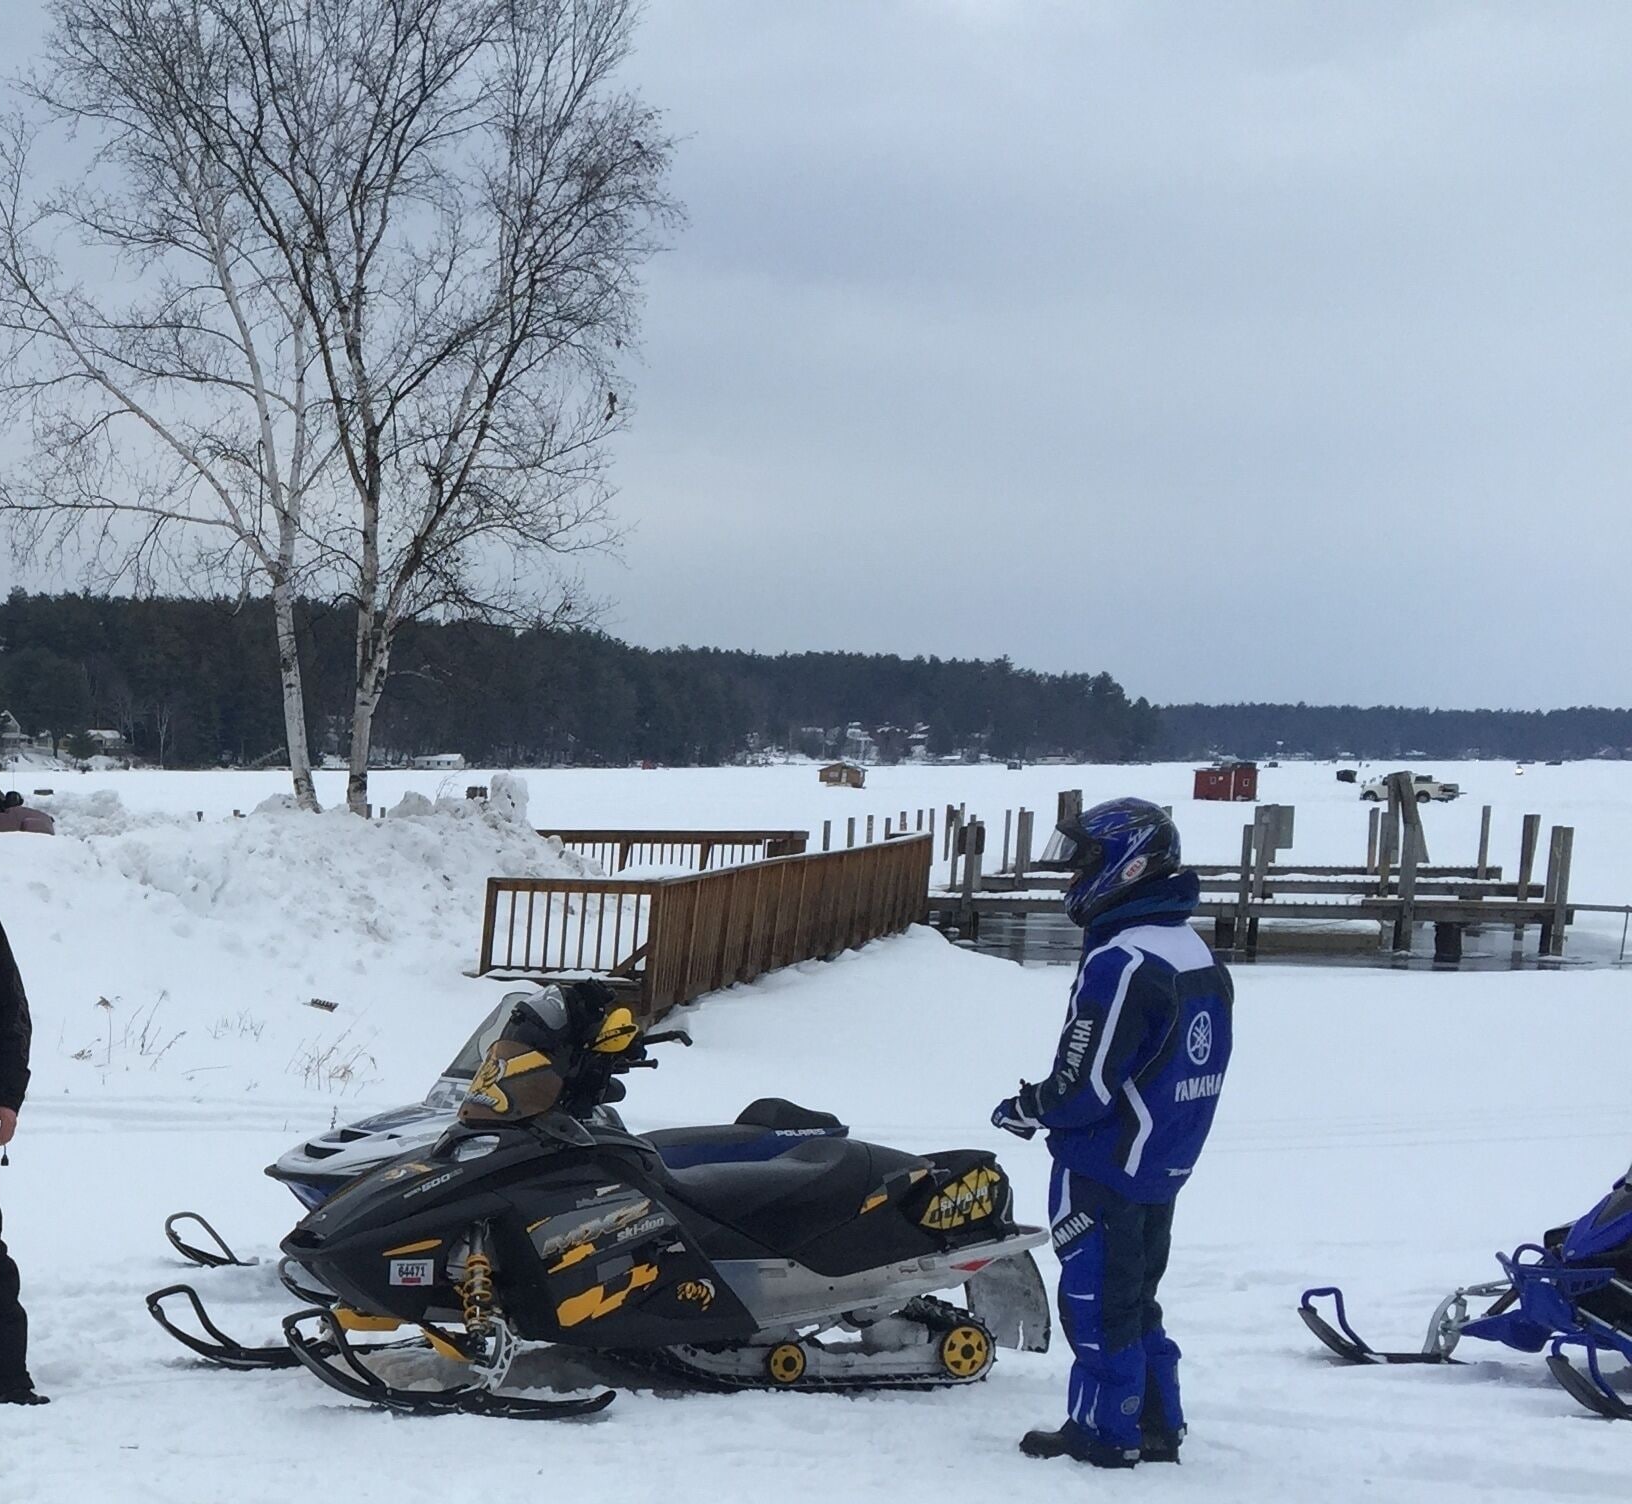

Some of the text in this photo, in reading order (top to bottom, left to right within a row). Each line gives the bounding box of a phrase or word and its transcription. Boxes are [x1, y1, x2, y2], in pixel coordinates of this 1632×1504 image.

[1061, 1019, 1094, 1083] YAMAHA
[1174, 1072, 1223, 1102] YAMAHA
[774, 1127, 827, 1137] POLARIS
[616, 1217, 665, 1242] ski-doo
[1052, 1211, 1095, 1250] AMAHA
